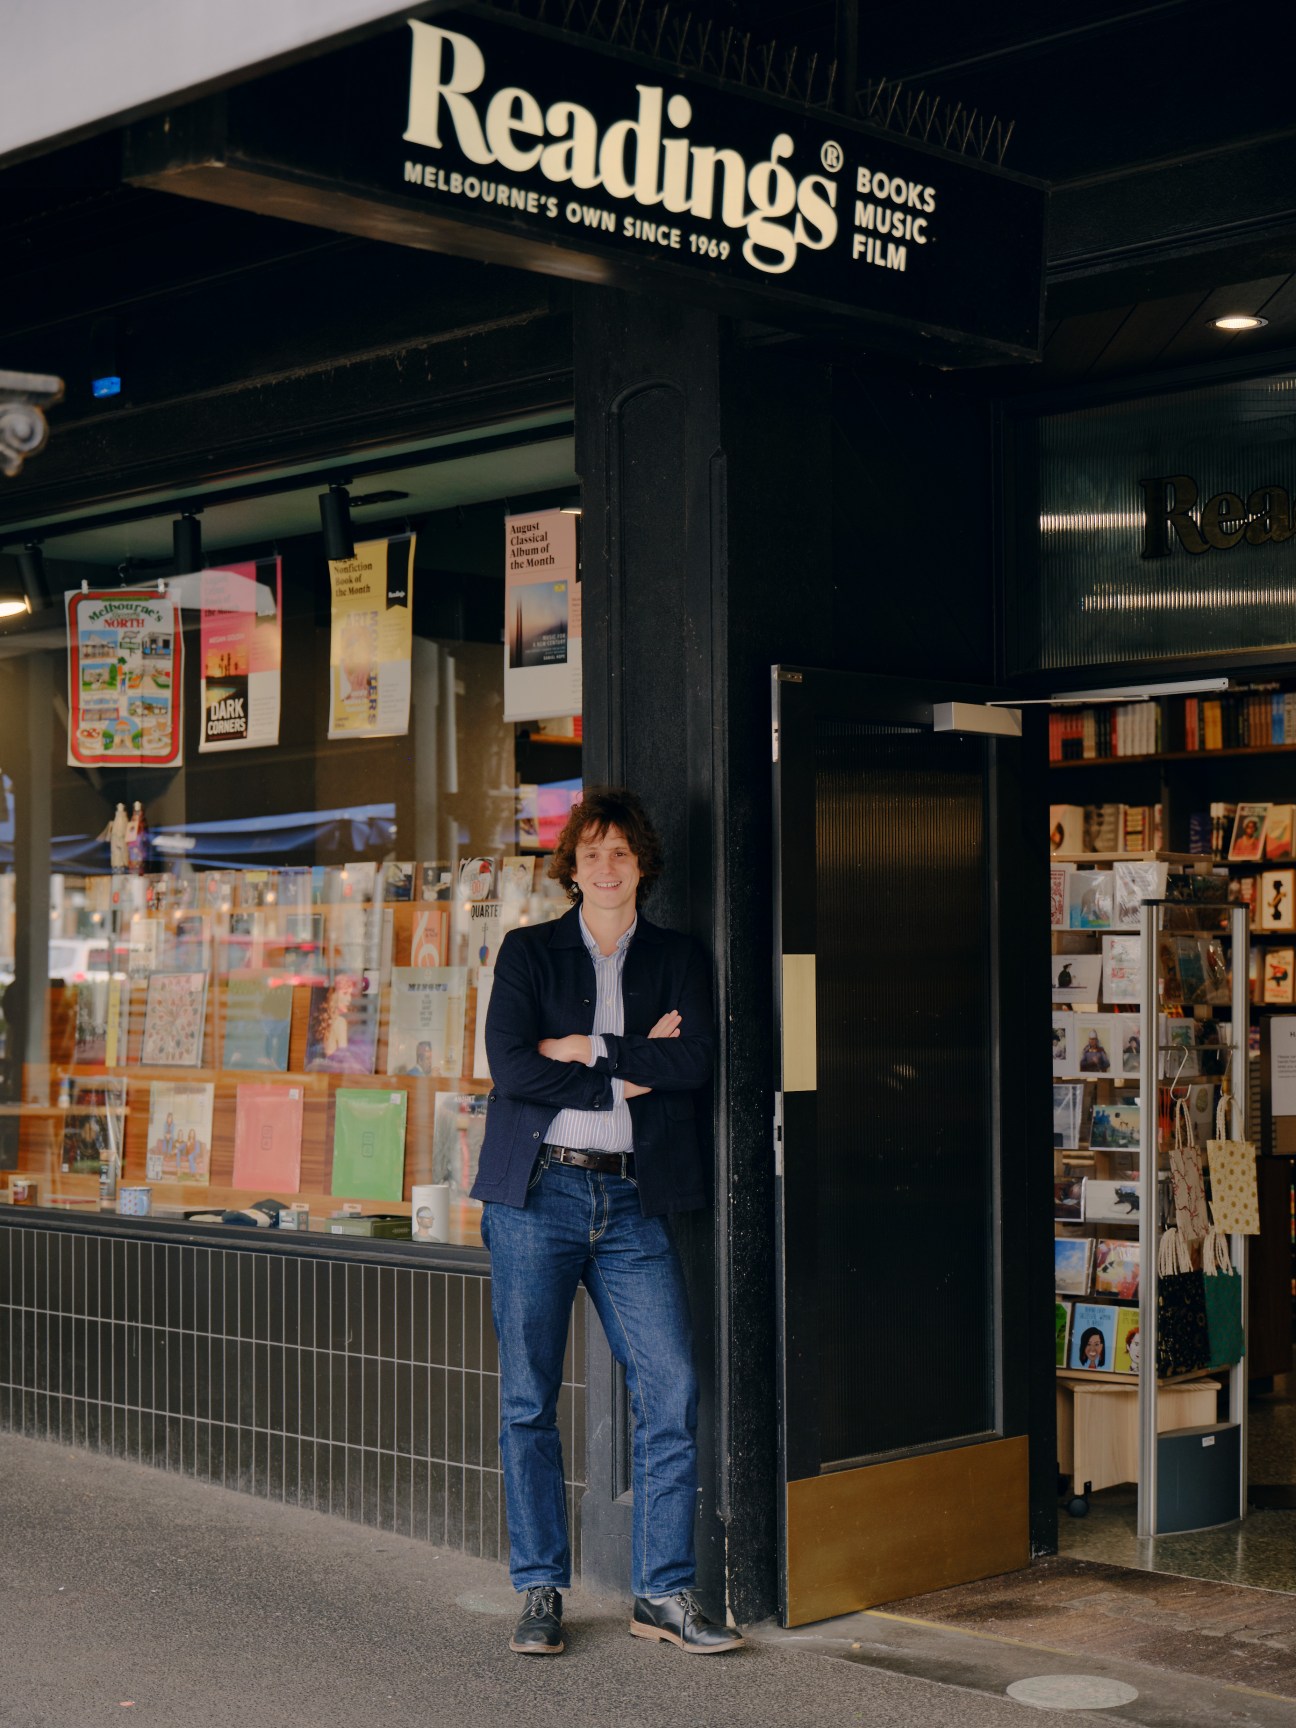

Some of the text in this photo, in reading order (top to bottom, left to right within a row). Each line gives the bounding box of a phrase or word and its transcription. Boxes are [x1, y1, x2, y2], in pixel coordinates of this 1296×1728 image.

[402, 18, 838, 274] Readings
[856, 166, 937, 214] BOOKS
[404, 160, 731, 261] MELBOURNE'S OWN SINCE 1969
[854, 200, 928, 245] MUSIC
[852, 233, 907, 272] FILM
[1139, 474, 1296, 559] Rea
[510, 522, 540, 534] August
[510, 531, 548, 546] Classical
[510, 543, 550, 558] Album of
[334, 561, 373, 574] Nonfiction
[510, 555, 555, 570] the Month
[335, 574, 362, 586] Book of
[335, 584, 371, 597] the Month
[88, 602, 163, 624] Melbourne's
[104, 618, 145, 628] NORTH
[211, 698, 245, 721] DARK
[207, 718, 247, 735] CORNERS
